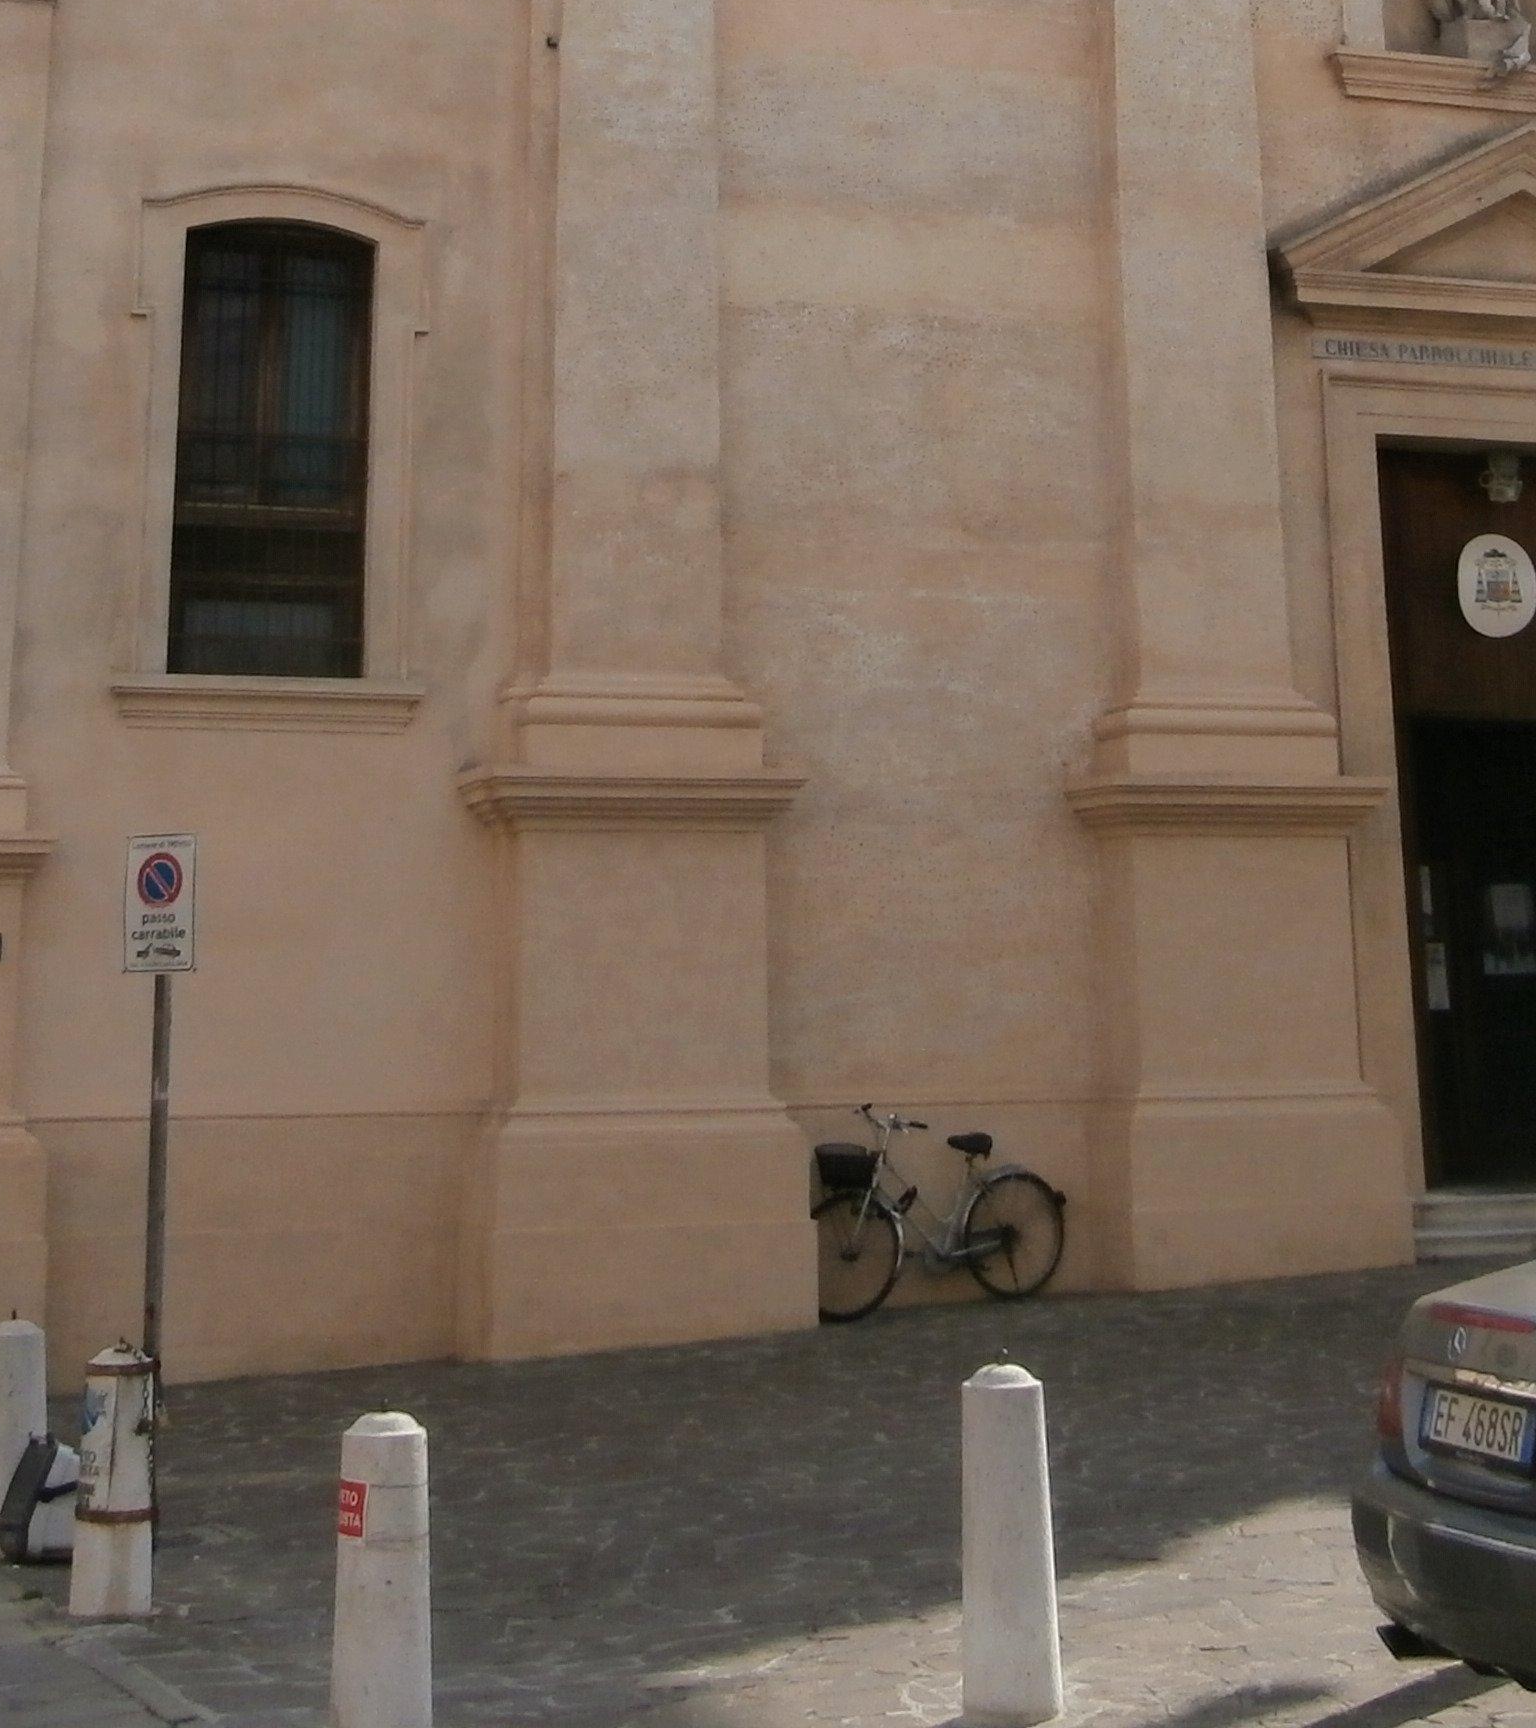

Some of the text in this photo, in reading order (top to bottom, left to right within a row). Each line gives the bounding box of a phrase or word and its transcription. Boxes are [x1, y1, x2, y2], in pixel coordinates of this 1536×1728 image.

[1324, 338, 1390, 360] CHIESA
[142, 913, 176, 926] passo
[131, 927, 187, 941] carrabile
[1432, 1392, 1525, 1457] EF 468SR
